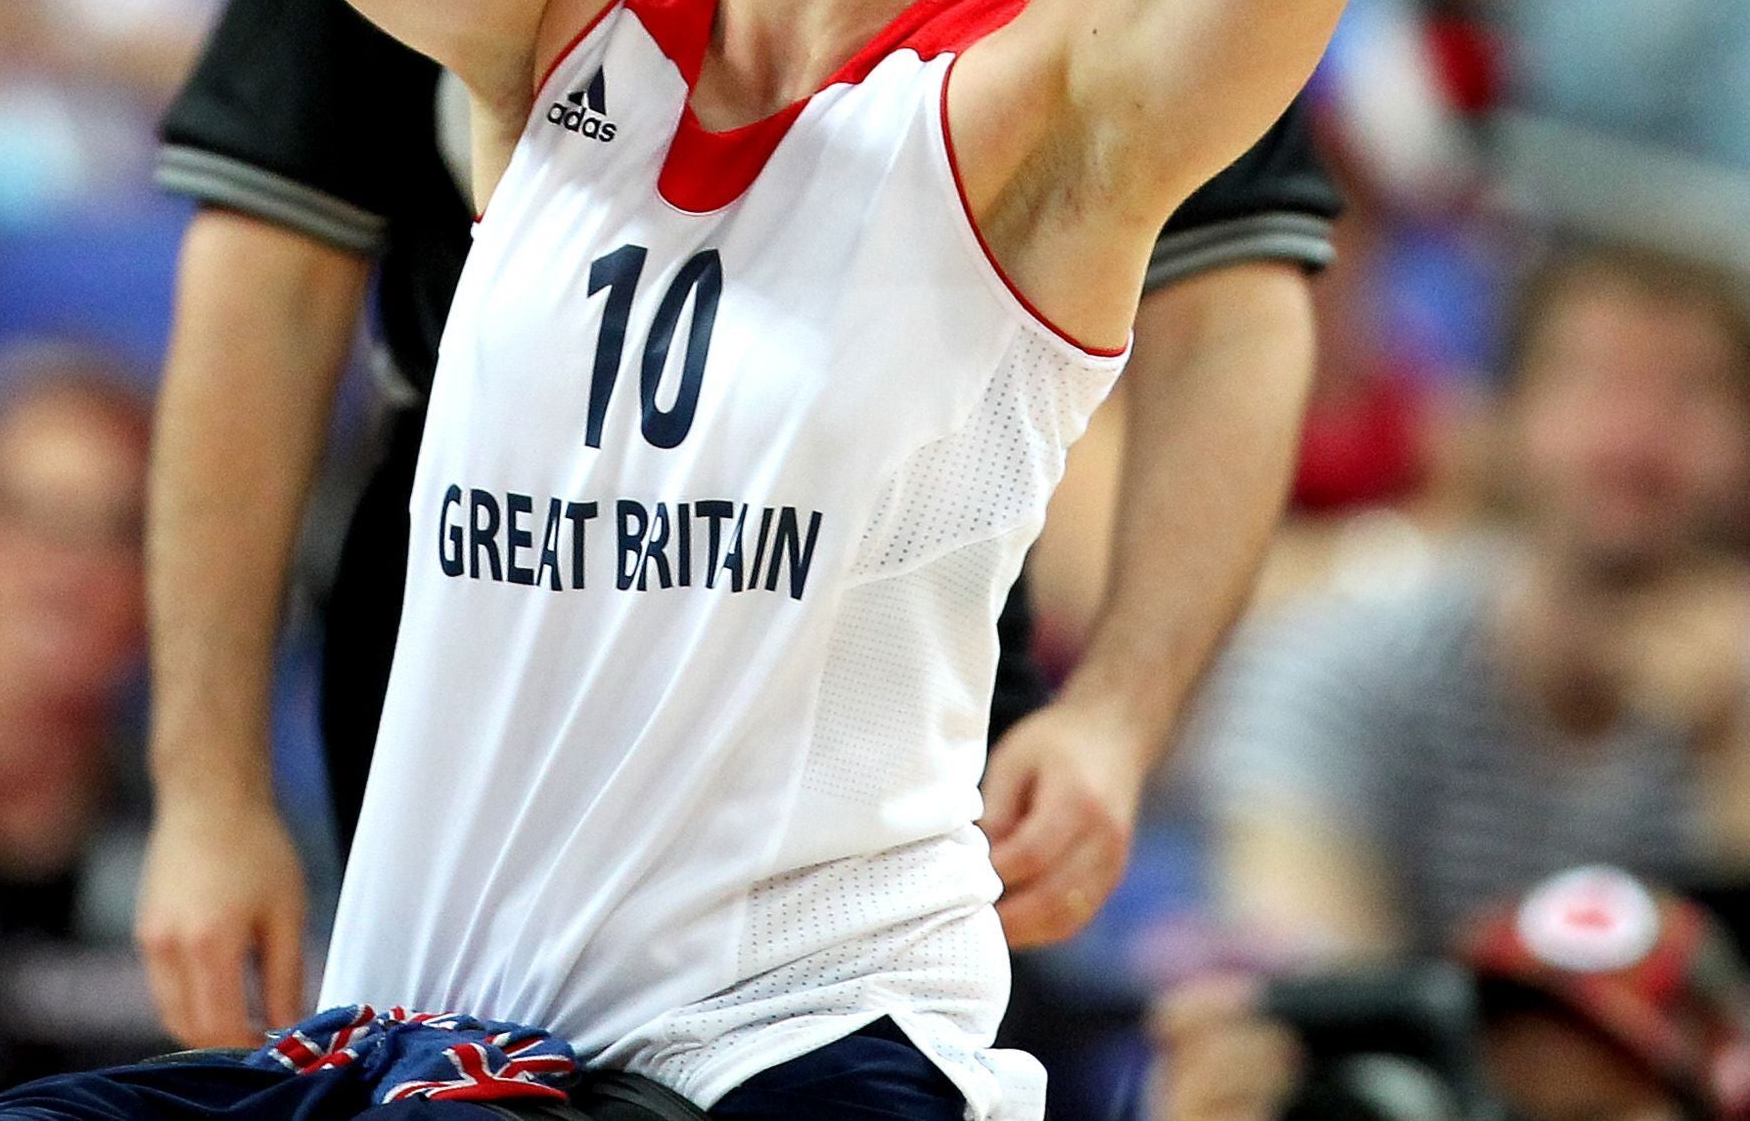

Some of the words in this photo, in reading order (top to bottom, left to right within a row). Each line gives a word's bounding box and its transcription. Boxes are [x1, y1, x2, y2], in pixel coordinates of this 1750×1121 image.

[585, 243, 723, 449] 10
[438, 483, 598, 592] GREAT
[616, 499, 823, 601] BRITAIN
